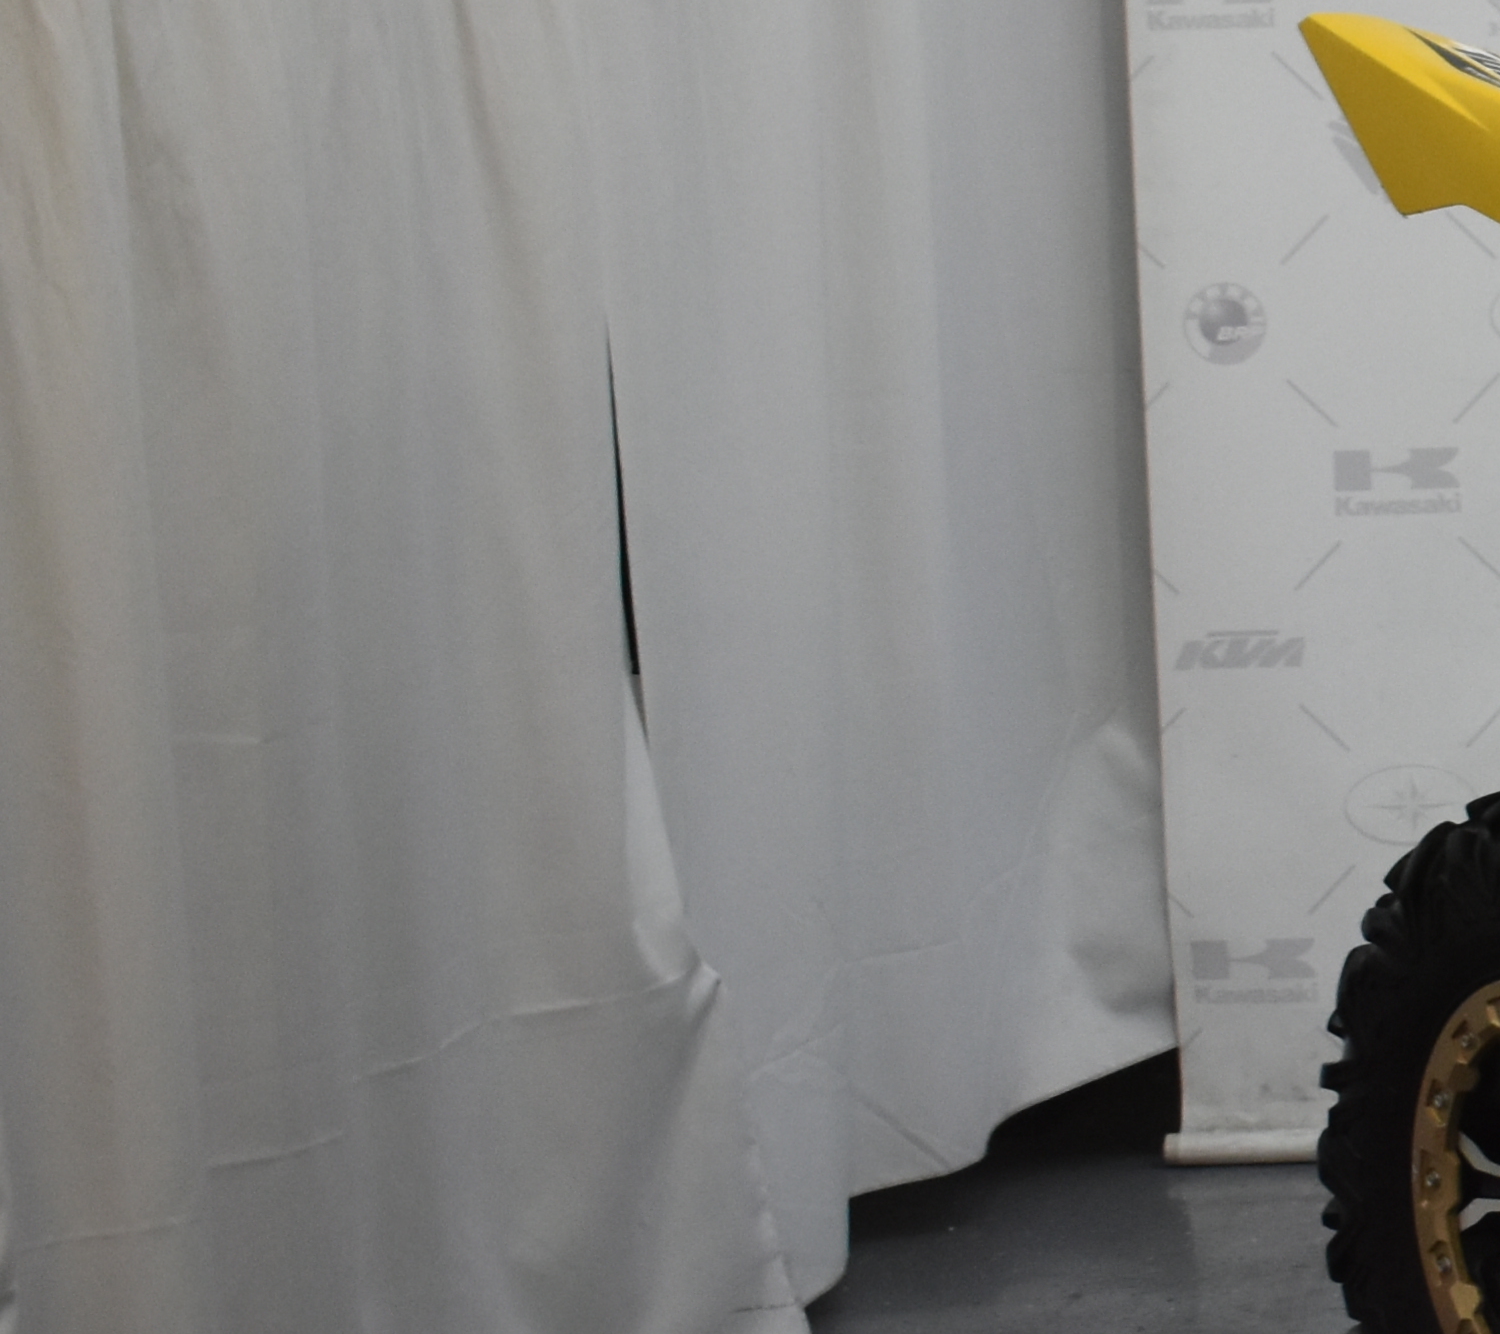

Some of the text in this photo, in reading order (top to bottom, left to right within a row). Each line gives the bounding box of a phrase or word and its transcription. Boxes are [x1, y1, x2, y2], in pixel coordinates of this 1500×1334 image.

[1146, 6, 1275, 32] Kawasaki
[1214, 325, 1264, 342] BRP
[1334, 494, 1462, 517] Kawasaki
[1172, 630, 1304, 673] KTM
[1193, 984, 1318, 1005] Kawasaki
